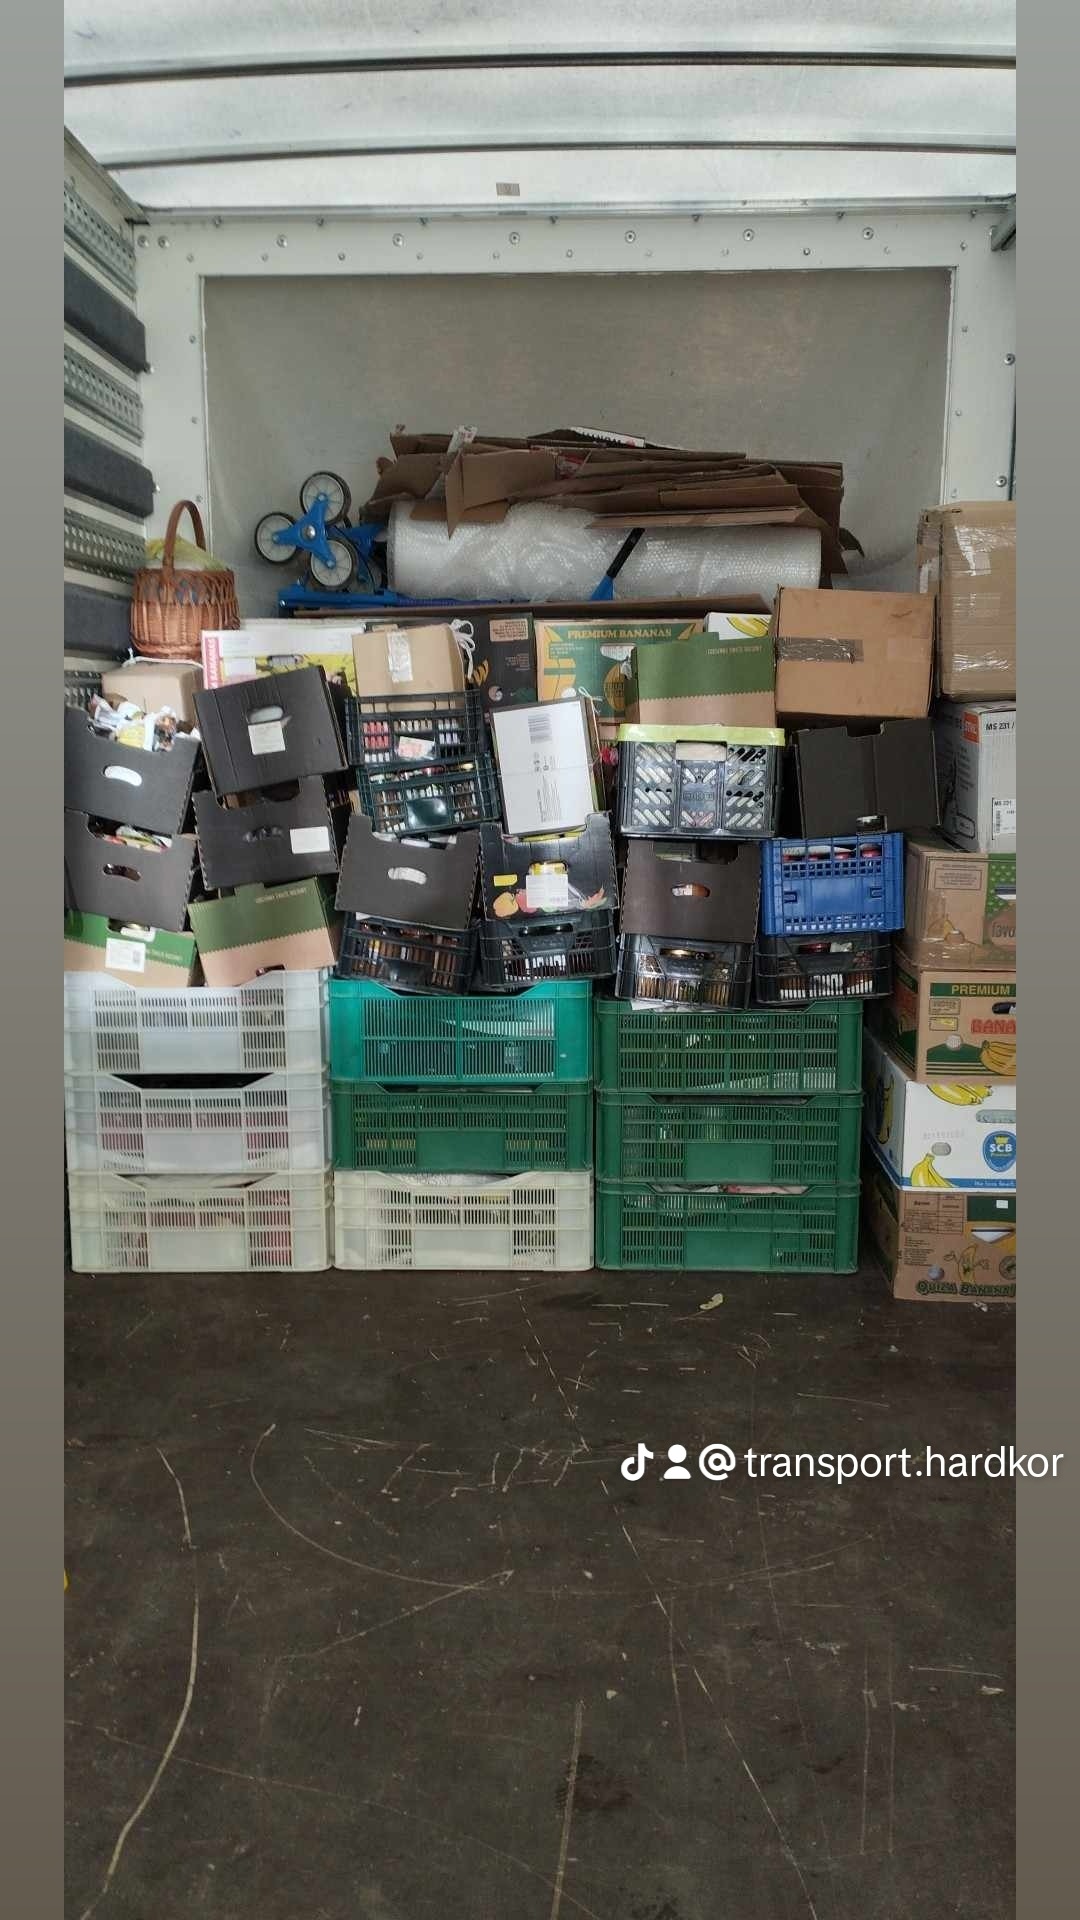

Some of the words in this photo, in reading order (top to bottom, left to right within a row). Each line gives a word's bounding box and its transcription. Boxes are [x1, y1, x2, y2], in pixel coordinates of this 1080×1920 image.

[567, 629, 617, 639] PREMIUM
[619, 628, 672, 638] BANANAS
[951, 984, 1011, 995] PREMIUM
[989, 1143, 1013, 1153] SCB
